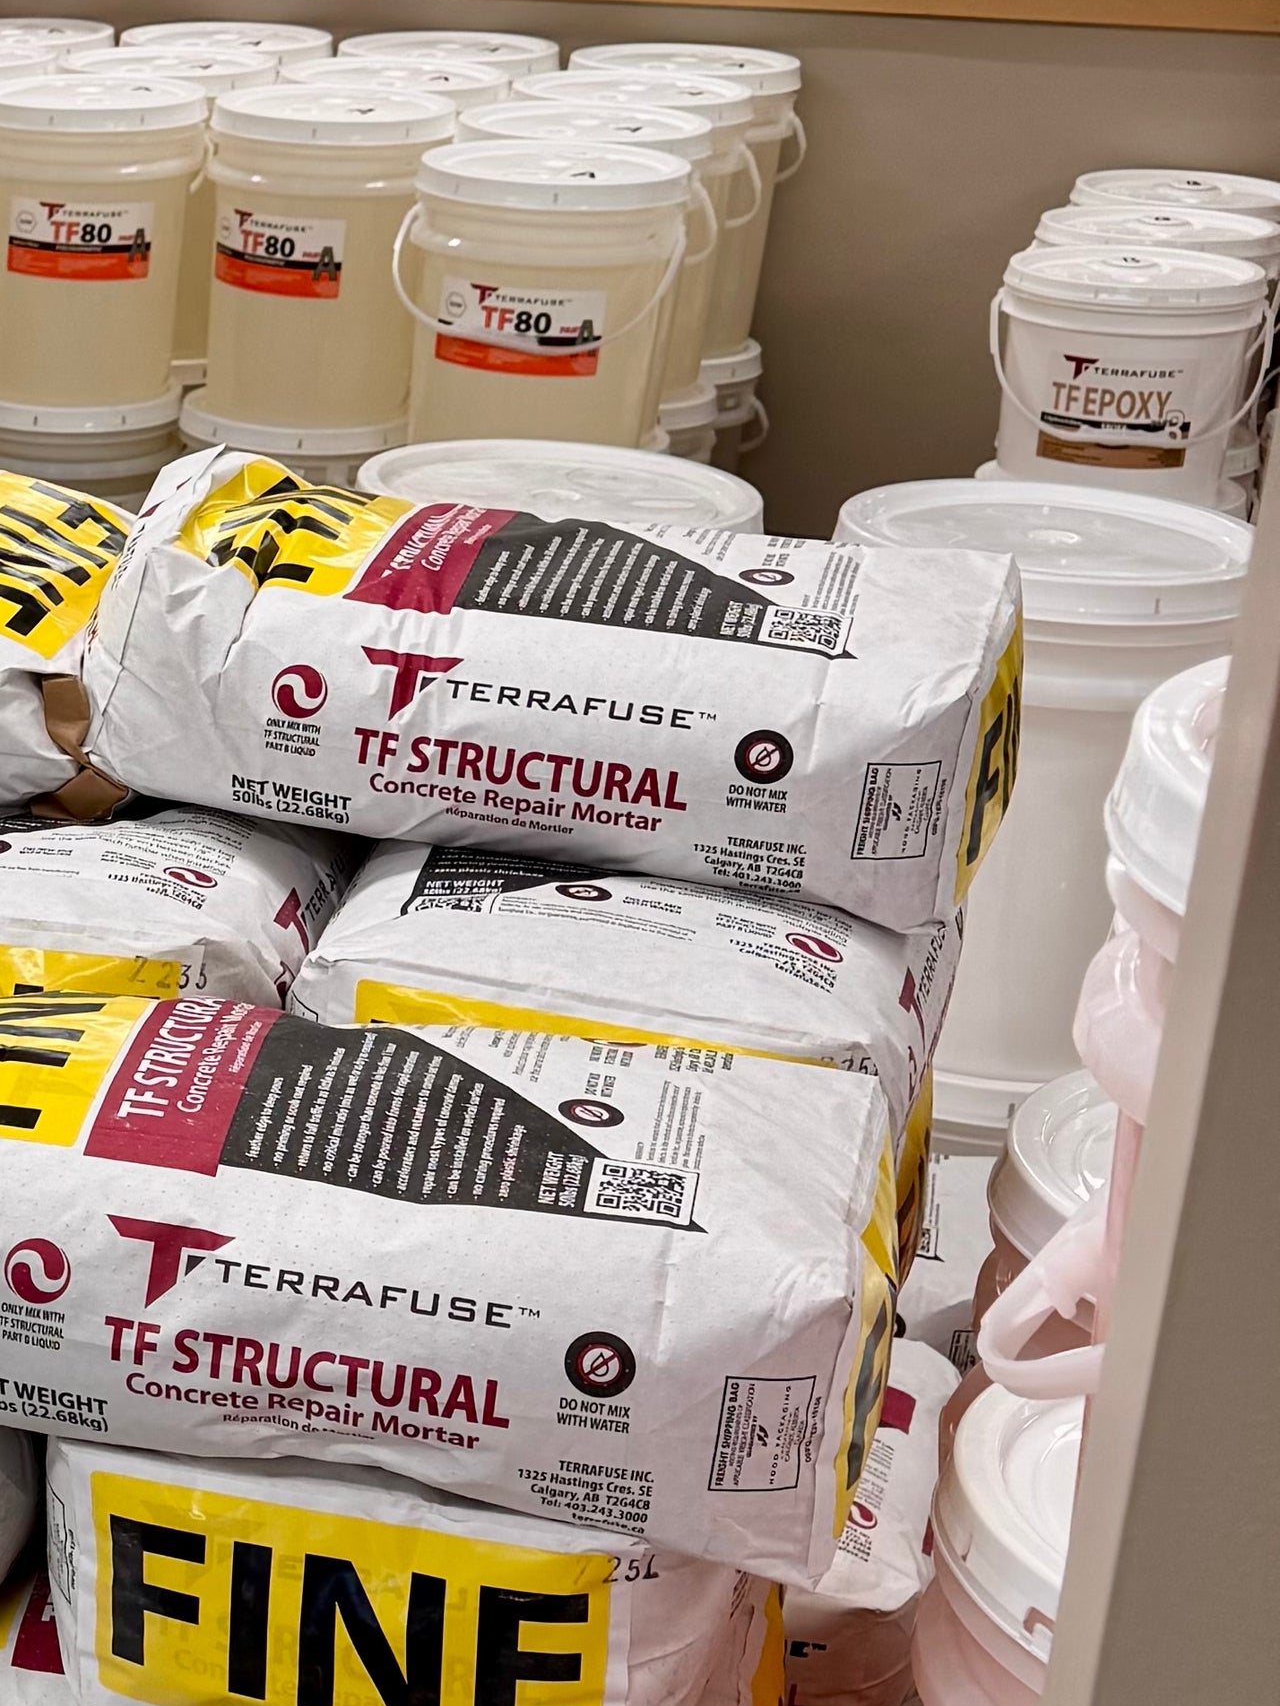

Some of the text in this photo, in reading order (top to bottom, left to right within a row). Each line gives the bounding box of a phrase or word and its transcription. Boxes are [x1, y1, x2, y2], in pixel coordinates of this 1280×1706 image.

[51, 221, 112, 245] TF80
[242, 229, 295, 259] TF80
[481, 305, 552, 334] TF80
[216, 1257, 514, 1330] TERRAFUSE
[104, 1315, 509, 1429] TF STRUCTURAL
[124, 1371, 260, 1412] Concrete
[370, 1410, 480, 1450] Mortar
[555, 1411, 630, 1434] WITH WATER
[582, 1399, 605, 1415] NOT
[606, 1402, 631, 1419] MIX
